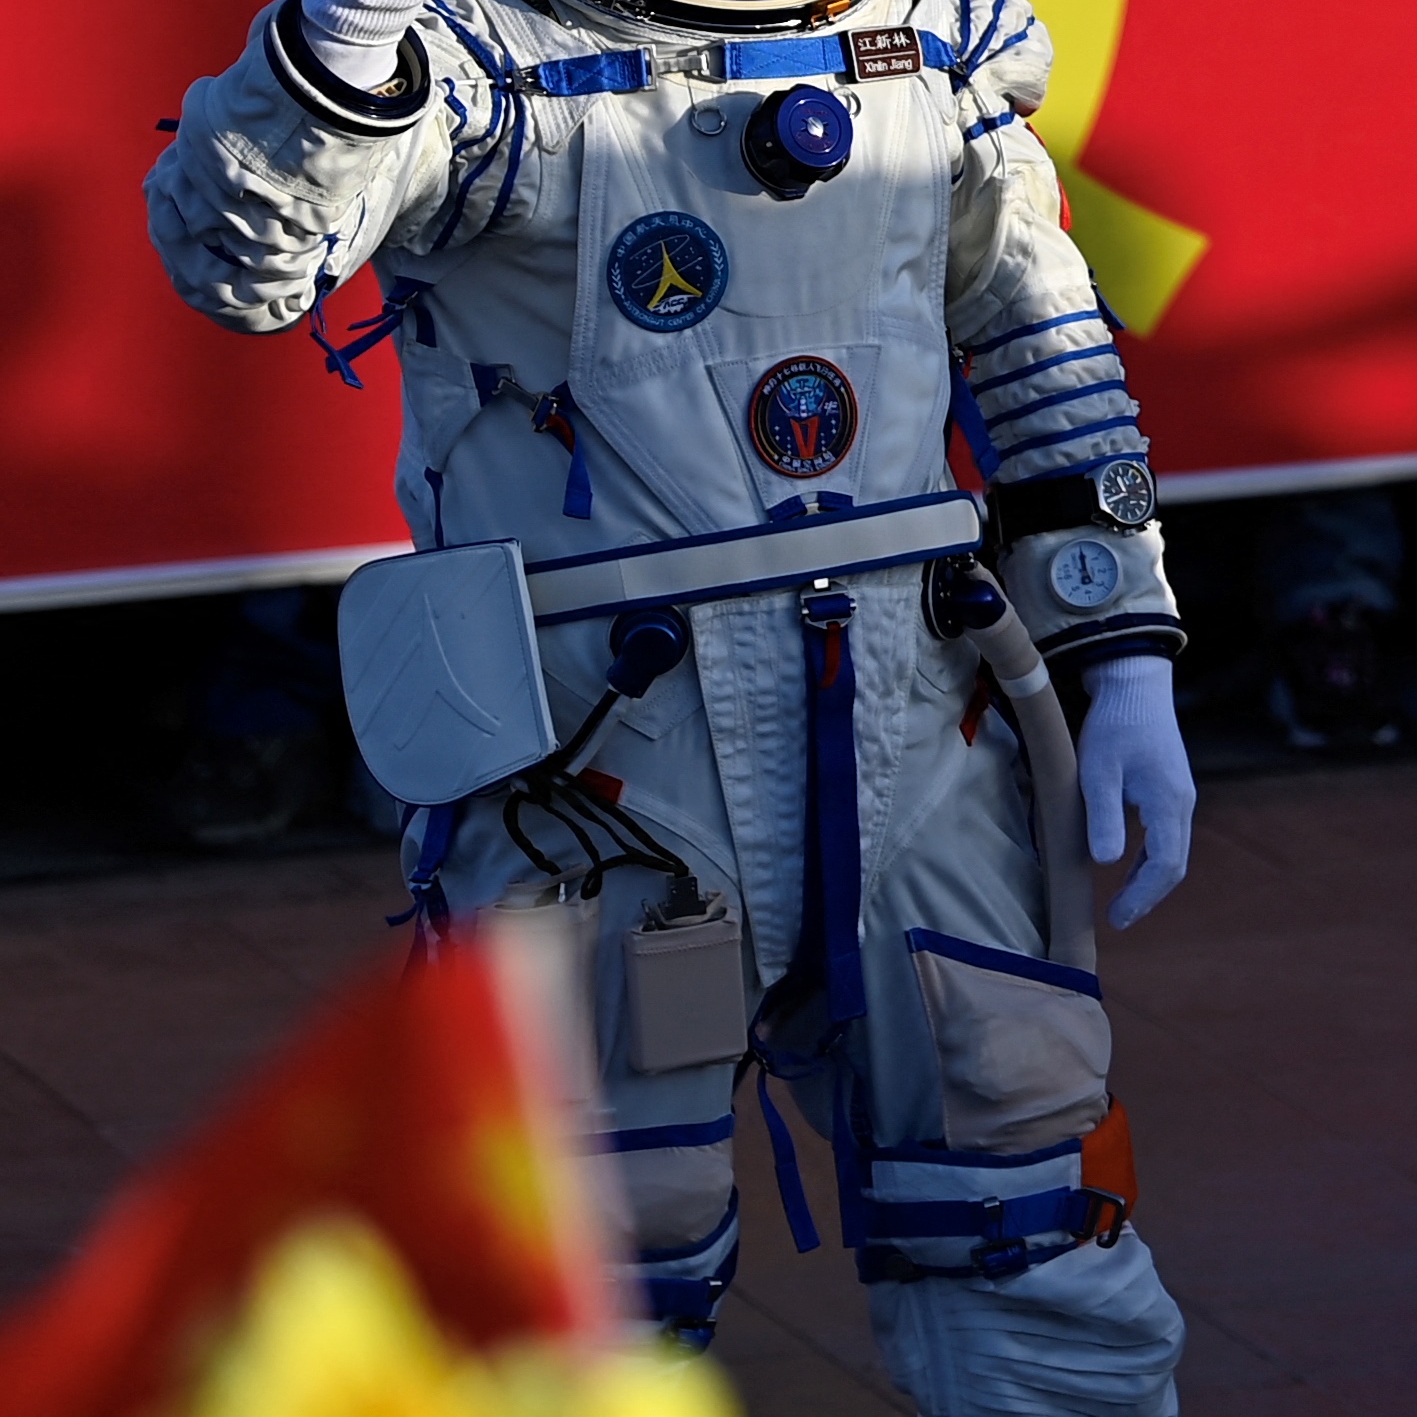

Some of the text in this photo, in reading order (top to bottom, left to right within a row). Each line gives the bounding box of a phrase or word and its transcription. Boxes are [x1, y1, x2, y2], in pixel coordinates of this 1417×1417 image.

[858, 31, 911, 51] 江新林
[864, 58, 913, 73] Xinlin Jiang
[616, 214, 708, 258] 中国航天员中心
[667, 312, 695, 327] CENTER
